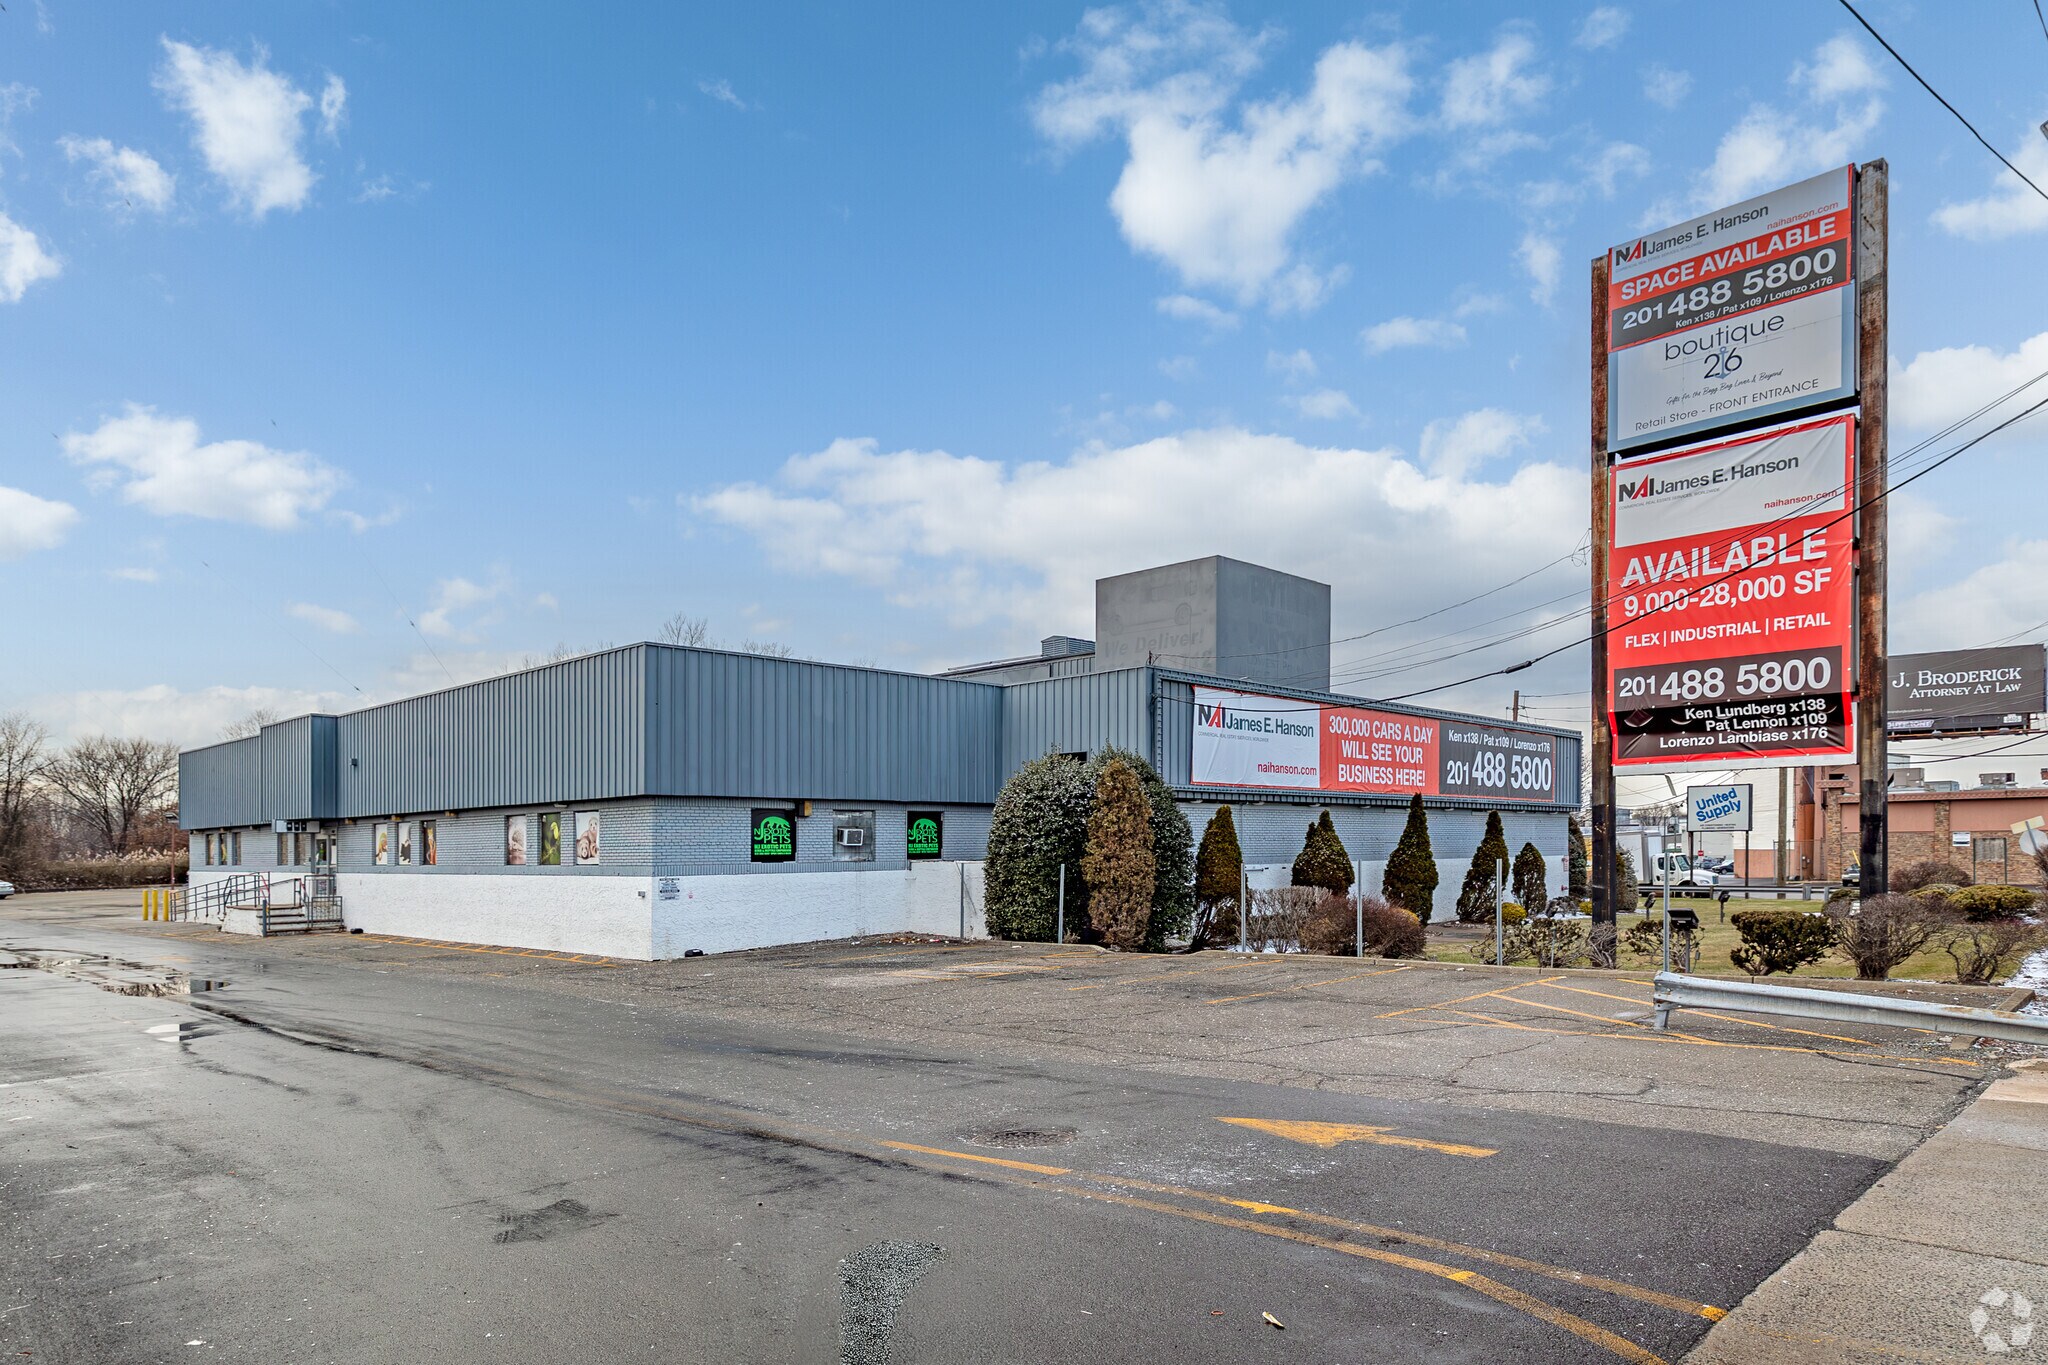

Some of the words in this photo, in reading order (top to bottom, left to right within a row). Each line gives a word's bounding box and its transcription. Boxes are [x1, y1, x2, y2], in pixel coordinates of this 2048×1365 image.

[1767, 201, 1839, 230] naihanson.com
[1616, 239, 1647, 266] NAI
[1648, 232, 1692, 254] James
[1697, 224, 1709, 238] E.
[1714, 206, 1769, 232] Hanson
[1621, 262, 1694, 300] SPACE
[1700, 216, 1836, 276] AVAILABLE
[1622, 302, 1664, 330] 201
[1667, 280, 1732, 317] 488
[1742, 247, 1837, 296] 5800
[1675, 317, 1693, 329] Ken
[1694, 311, 1715, 324] x138
[1722, 304, 1738, 316] Pat
[1740, 297, 1762, 312] x109
[1769, 285, 1808, 302] Lorenzo
[1809, 276, 1833, 290] x176
[1665, 315, 1785, 361] boutique
[1703, 348, 1743, 379] 26
[1758, 369, 1784, 381] Beyond
[1635, 415, 1666, 431] Retail
[1669, 408, 1699, 422] Store
[1709, 395, 1748, 413] FRONT
[1752, 378, 1819, 403] ENTRANCE
[1619, 474, 1654, 502] NAI
[1655, 475, 1709, 495] James
[1712, 468, 1728, 484] E.
[1731, 456, 1799, 481] Hanson
[1764, 489, 1838, 510] naihanson.com
[1620, 527, 1828, 588] AVAILABLE
[1624, 574, 1786, 619] 9,000-28,000
[1794, 567, 1832, 595] SF
[1135, 629, 1204, 653] Deliver!
[1625, 633, 1660, 648] FLEX
[1670, 621, 1761, 643] INDUSTRIAL
[1773, 612, 1831, 631] RETAIL
[1619, 675, 1656, 698] 201
[1660, 667, 1725, 701] 488
[1736, 656, 1832, 696] 5800
[1891, 672, 1911, 688] J.
[1917, 667, 2022, 687] BRODERICK
[1198, 701, 1226, 728] NAI
[1226, 713, 1262, 732] James
[1264, 717, 1274, 733] E.
[1275, 719, 1314, 737] Hanson
[1685, 708, 1715, 720] Ken
[1716, 701, 1786, 718] Lundberg
[1789, 698, 1826, 712] x138
[1706, 720, 1730, 731] Pat
[1733, 715, 1788, 730] Lennon
[1791, 712, 1828, 726] x109
[1329, 715, 1370, 738] 300,000
[1372, 720, 1401, 741] CARS
[1403, 725, 1411, 742] A
[1413, 726, 1433, 744] DAY
[1448, 729, 1463, 742] Ken
[1463, 732, 1479, 744] x138
[1483, 735, 1494, 746] Pat
[1495, 736, 1510, 748] x109
[1513, 738, 1537, 752] Lorenzo
[1537, 743, 1551, 753] x176
[1660, 735, 1714, 748] Lorenzo
[1718, 730, 1788, 744] Lambiase
[1792, 727, 1828, 740] x176
[1341, 740, 1369, 759] WILL
[1371, 742, 1392, 761] SEE
[1394, 745, 1423, 764] YOUR
[1257, 761, 1317, 775] naihanson.com
[1338, 763, 1393, 784] BUSINESS
[1395, 768, 1425, 786] HERE!
[1446, 760, 1469, 785] 201
[1471, 751, 1506, 788] 488
[1510, 754, 1552, 791] 5800
[1695, 787, 1738, 810] United
[1695, 800, 1741, 822] Supply
[763, 834, 791, 843] PETS
[915, 834, 938, 843] PETS
